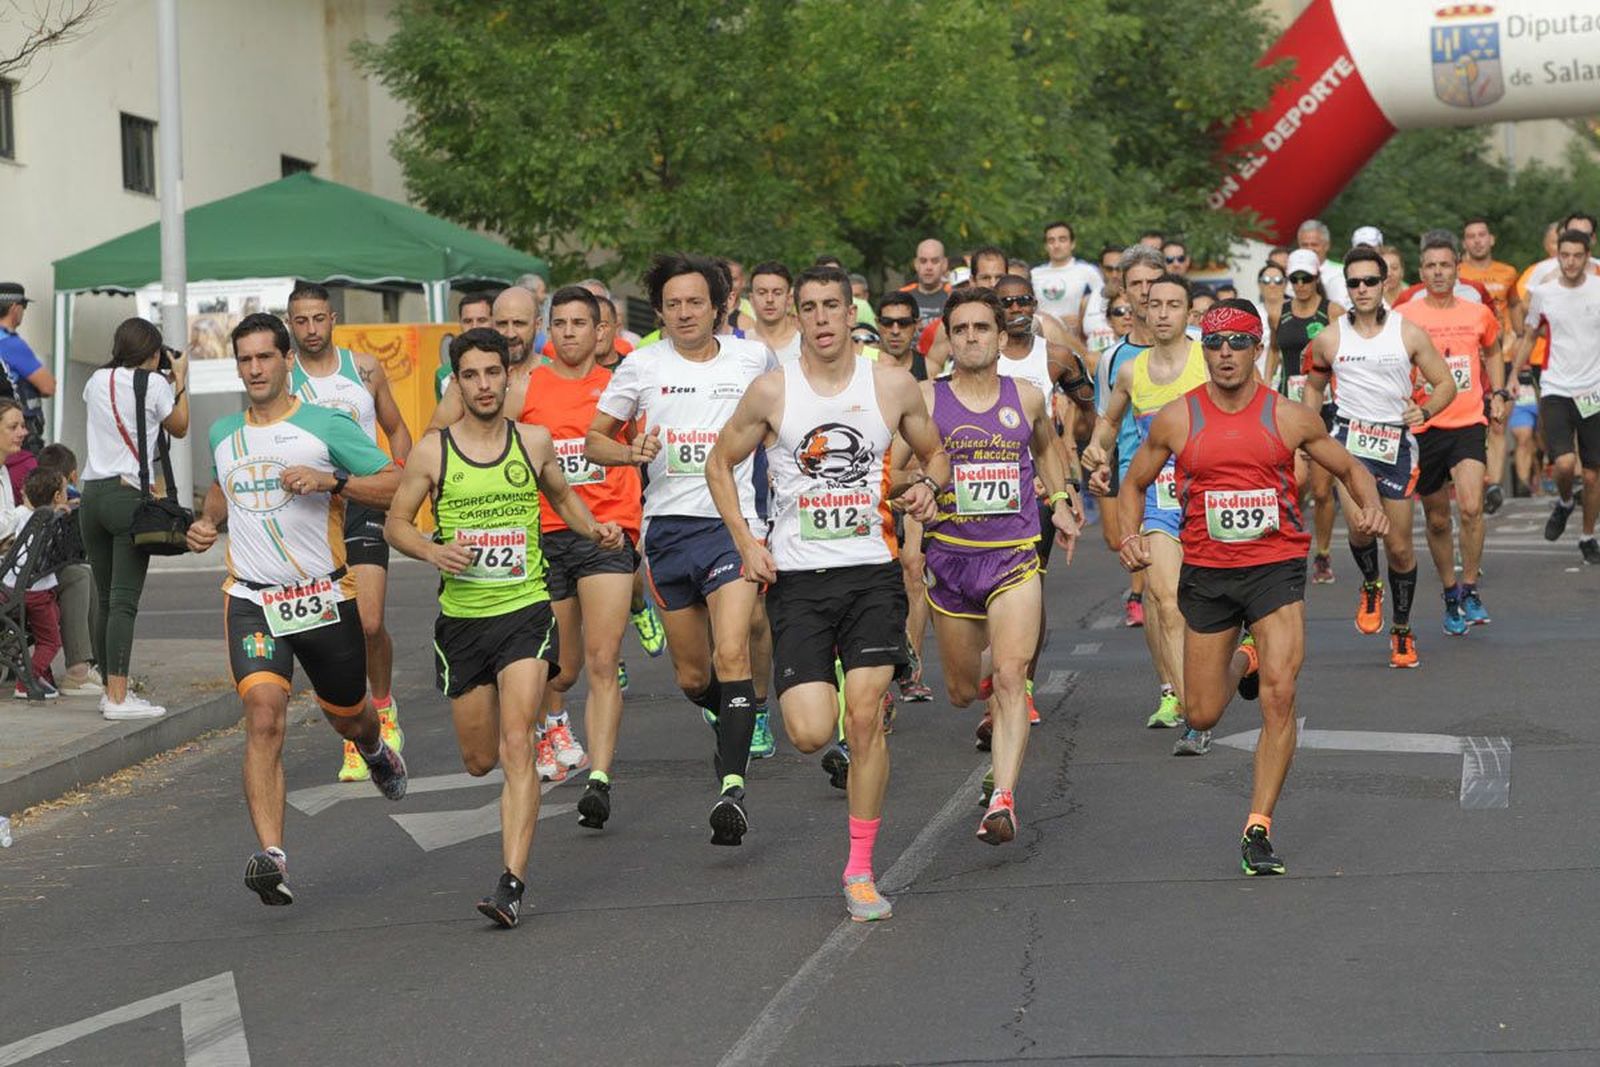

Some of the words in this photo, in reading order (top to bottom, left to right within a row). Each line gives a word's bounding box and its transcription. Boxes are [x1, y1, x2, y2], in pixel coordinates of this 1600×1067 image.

[1510, 67, 1533, 86] de
[1262, 55, 1354, 152] DEPORTE
[670, 386, 696, 394] Zeus
[1357, 434, 1389, 453] 875
[679, 445, 706, 464] 85
[956, 466, 1019, 481] bedunia
[799, 492, 871, 508] bedunia
[968, 481, 1010, 501] 770
[1207, 495, 1277, 509] bedunia
[460, 506, 527, 520] CARBAJOSA
[813, 507, 858, 529] 812
[1221, 509, 1265, 530] 839
[470, 547, 514, 567] 762
[263, 580, 333, 606] bedunia
[279, 595, 322, 621] 863
